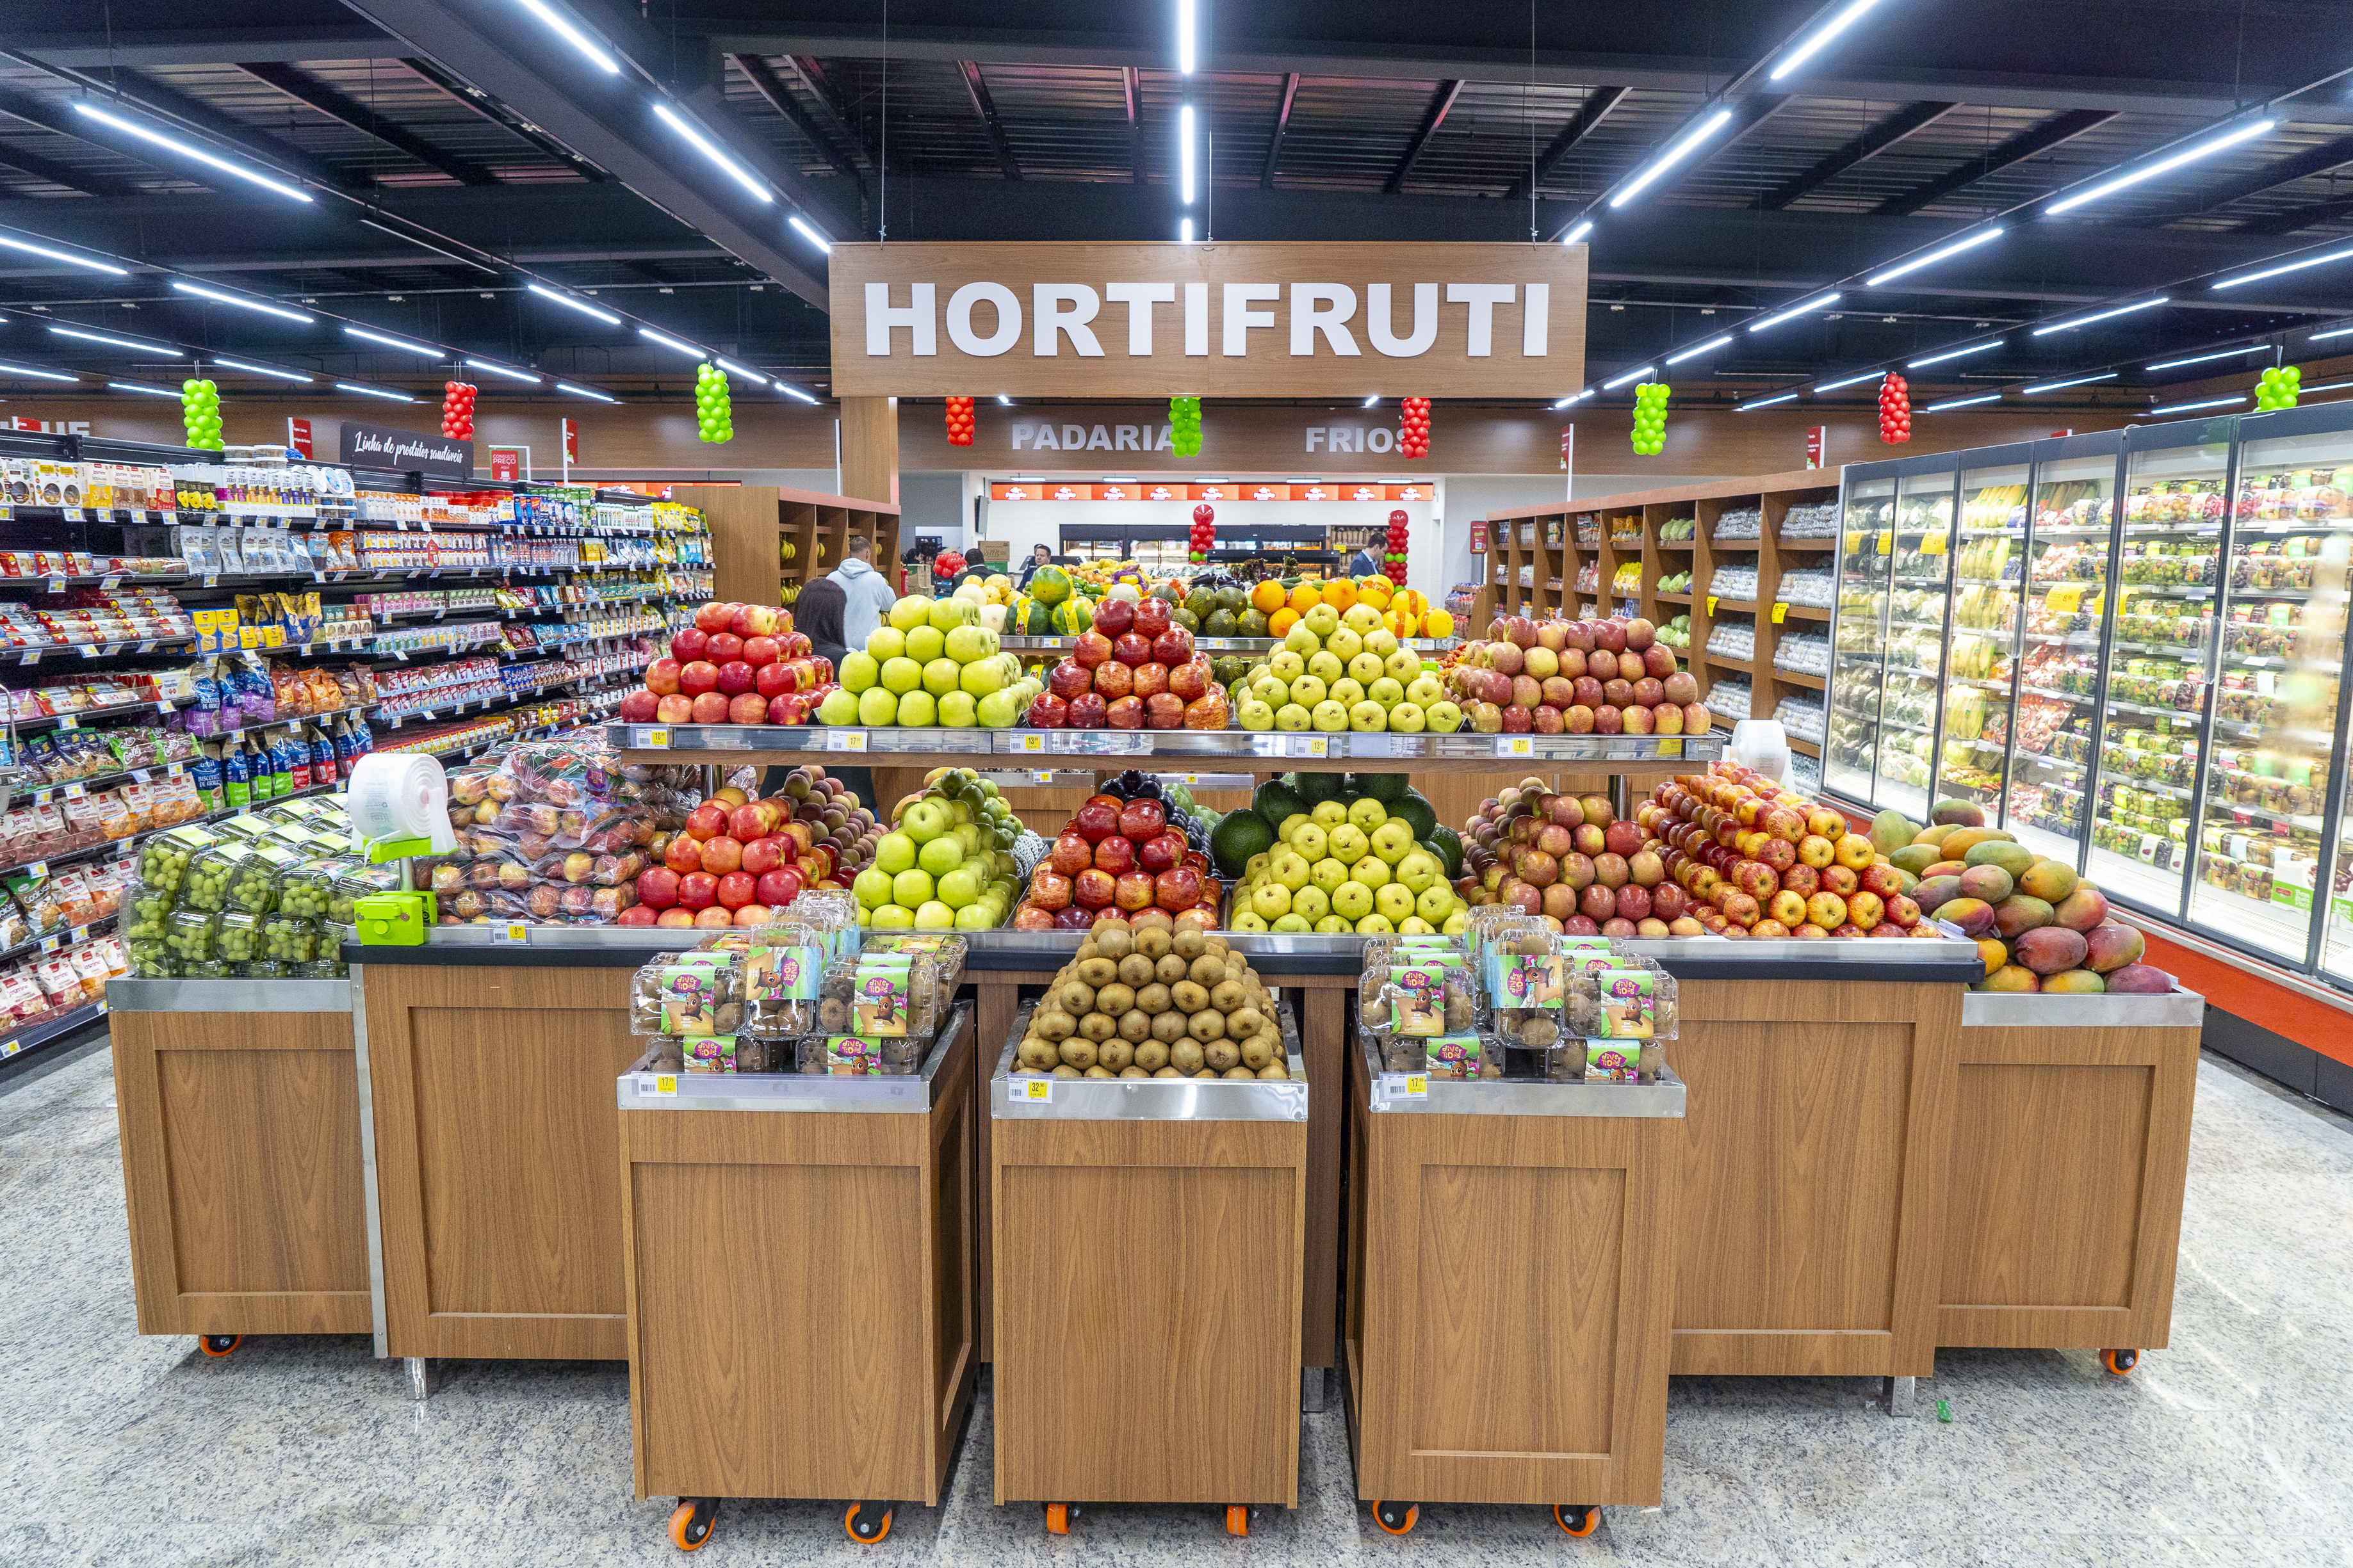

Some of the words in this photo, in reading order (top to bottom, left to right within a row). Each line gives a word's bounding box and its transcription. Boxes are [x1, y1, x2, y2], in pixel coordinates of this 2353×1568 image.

[865, 281, 1550, 357] HORTIFRUTI
[354, 431, 382, 452] Linha
[383, 436, 395, 454] de
[393, 440, 429, 465] produtos
[429, 445, 463, 464] saudáveis
[1011, 424, 1174, 451] PADARIA
[24, 882, 51, 904] Cookies
[0, 901, 15, 917] okies
[1411, 1078, 1424, 1087] 17,99
